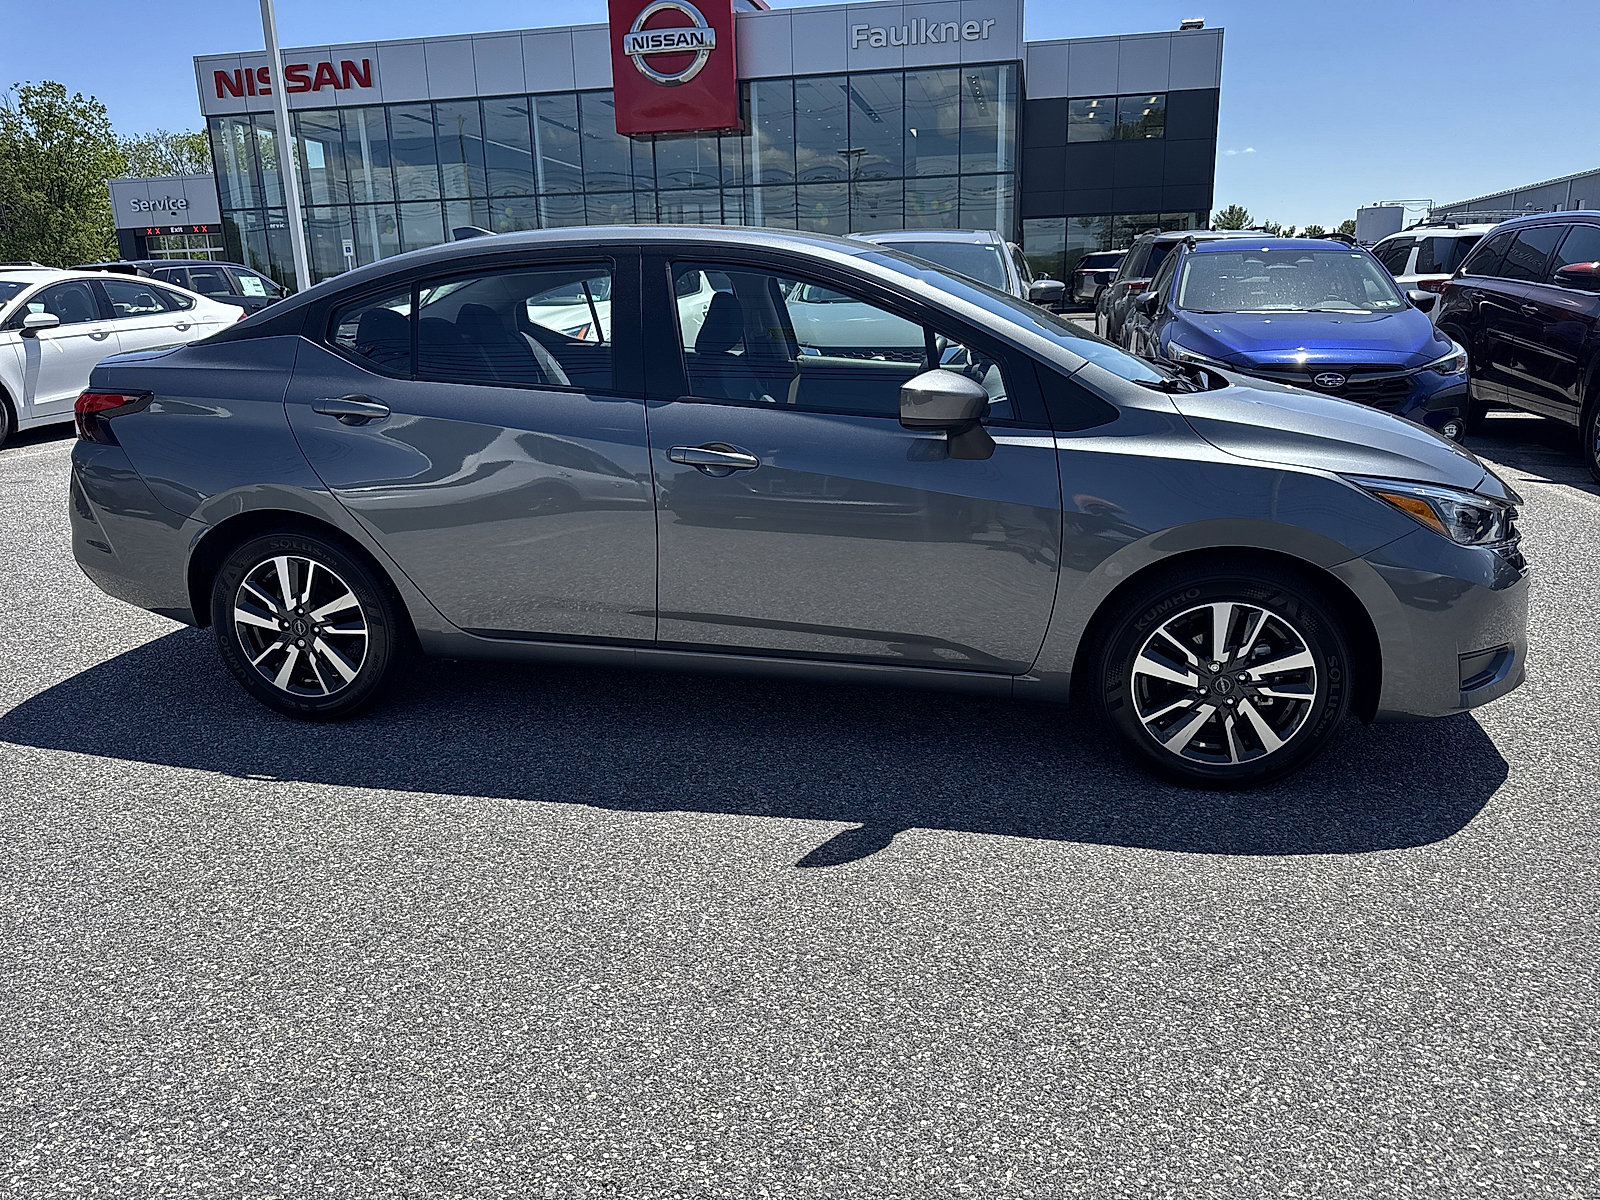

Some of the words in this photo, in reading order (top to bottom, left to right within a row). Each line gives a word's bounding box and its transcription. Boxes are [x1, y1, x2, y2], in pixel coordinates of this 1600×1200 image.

[631, 32, 704, 50] NISSAN
[851, 18, 996, 49] Faulkner
[213, 59, 373, 99] NISSAN
[130, 195, 188, 212] Service
[170, 226, 184, 234] Exit
[1133, 588, 1201, 632] KUMHO
[1324, 655, 1341, 720] SOLUS
